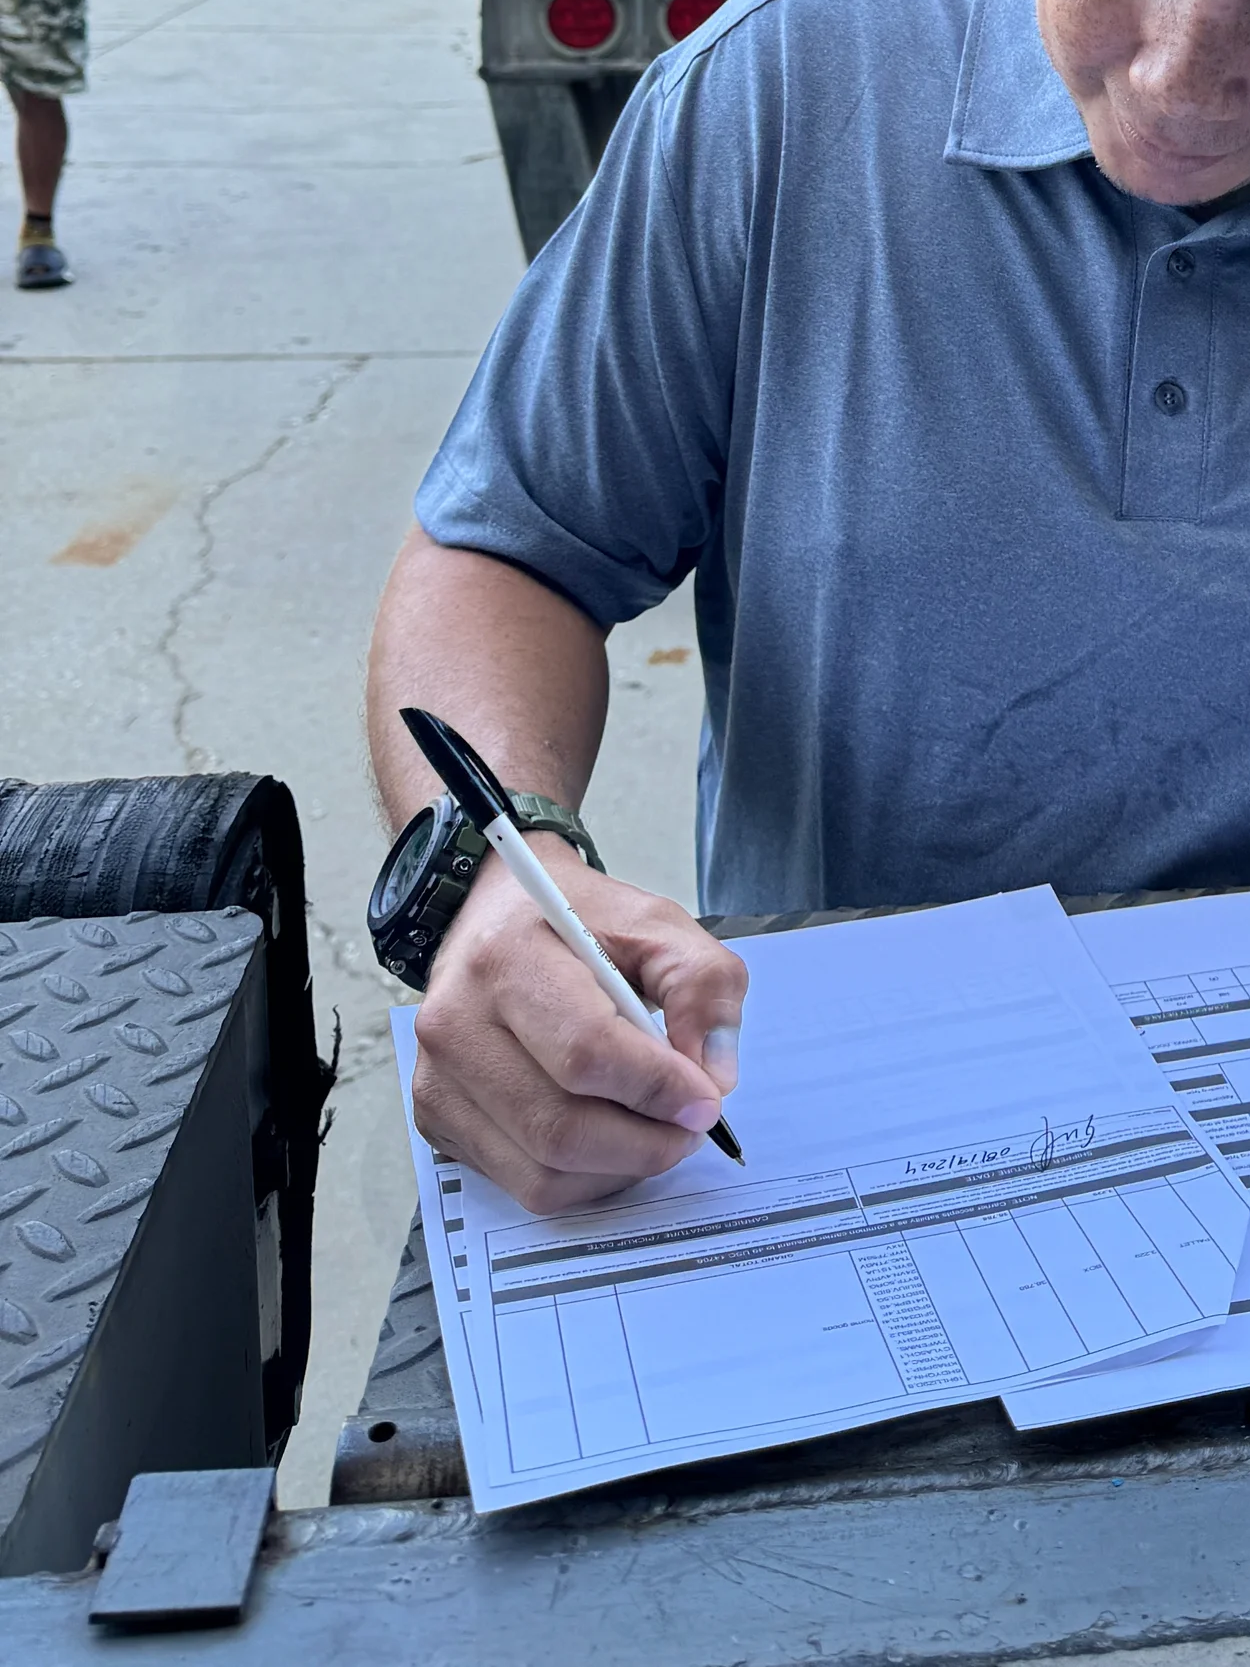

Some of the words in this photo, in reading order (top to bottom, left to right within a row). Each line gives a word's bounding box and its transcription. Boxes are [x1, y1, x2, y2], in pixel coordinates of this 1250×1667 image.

[965, 1172, 990, 1182] DATE
[976, 1201, 1006, 1210] Carrier
[940, 1206, 975, 1217] accepts
[723, 1214, 768, 1227] CARRIER
[909, 1213, 939, 1223] liability
[663, 1223, 721, 1239] SIGNATURE
[848, 1223, 887, 1234] common
[616, 1234, 654, 1246] PICKUP
[818, 1231, 847, 1240] carrier
[586, 1240, 614, 1251] DATE
[776, 1236, 816, 1248] pursuant
[1177, 1236, 1211, 1248] PALLET
[727, 1249, 749, 1257] USC
[760, 1252, 794, 1263] GRAND
[729, 1259, 759, 1269] TOTAL
[1081, 1263, 1103, 1273] BOX
[821, 1321, 849, 1332] goods
[849, 1317, 874, 1327] home
